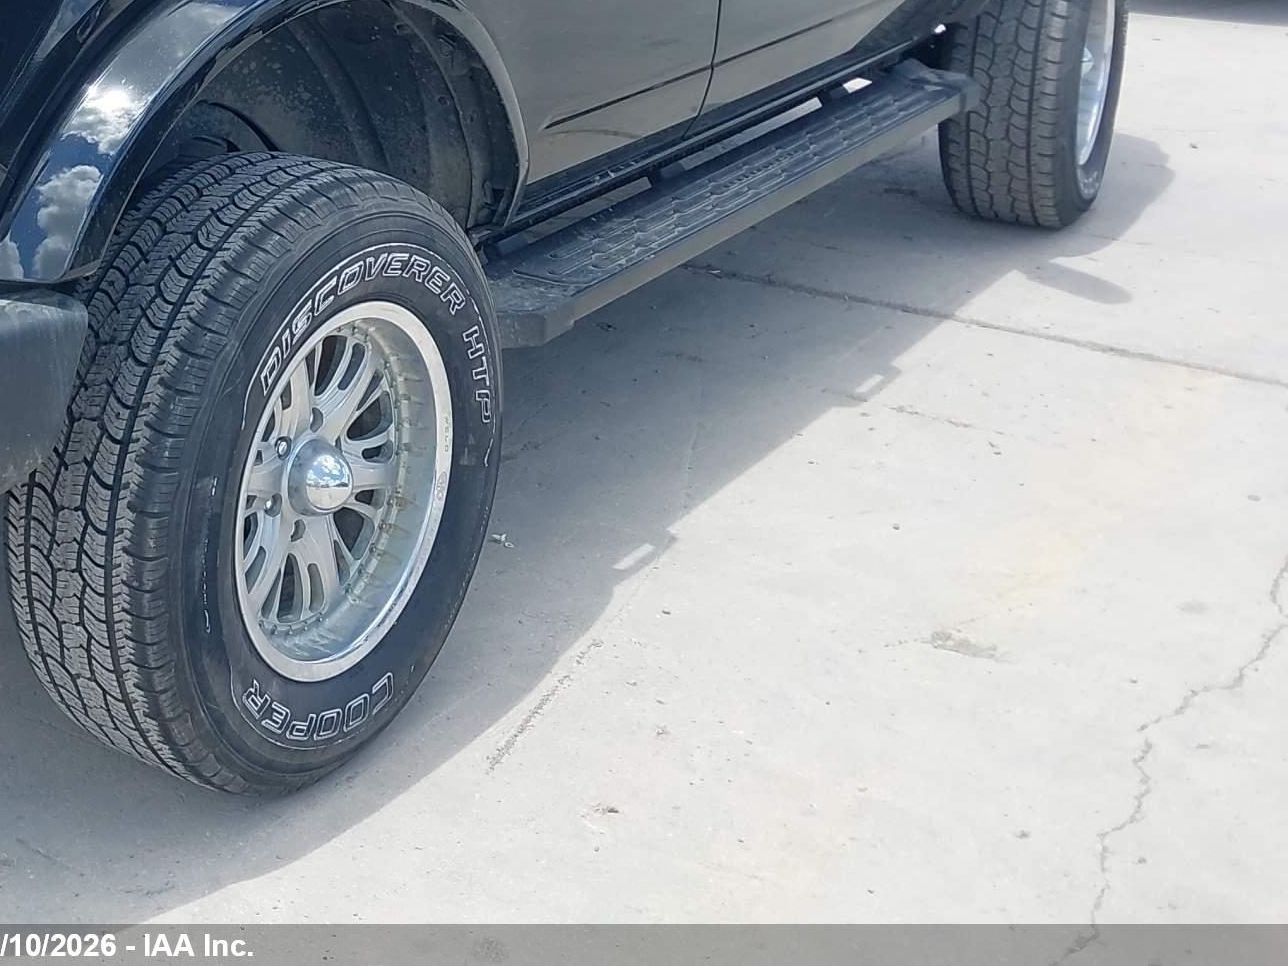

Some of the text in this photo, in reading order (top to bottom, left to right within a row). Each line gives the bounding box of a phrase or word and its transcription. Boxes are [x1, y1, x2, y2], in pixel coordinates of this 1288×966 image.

[260, 252, 493, 424] DISCOVERER HTP
[242, 672, 394, 741] COOPER
